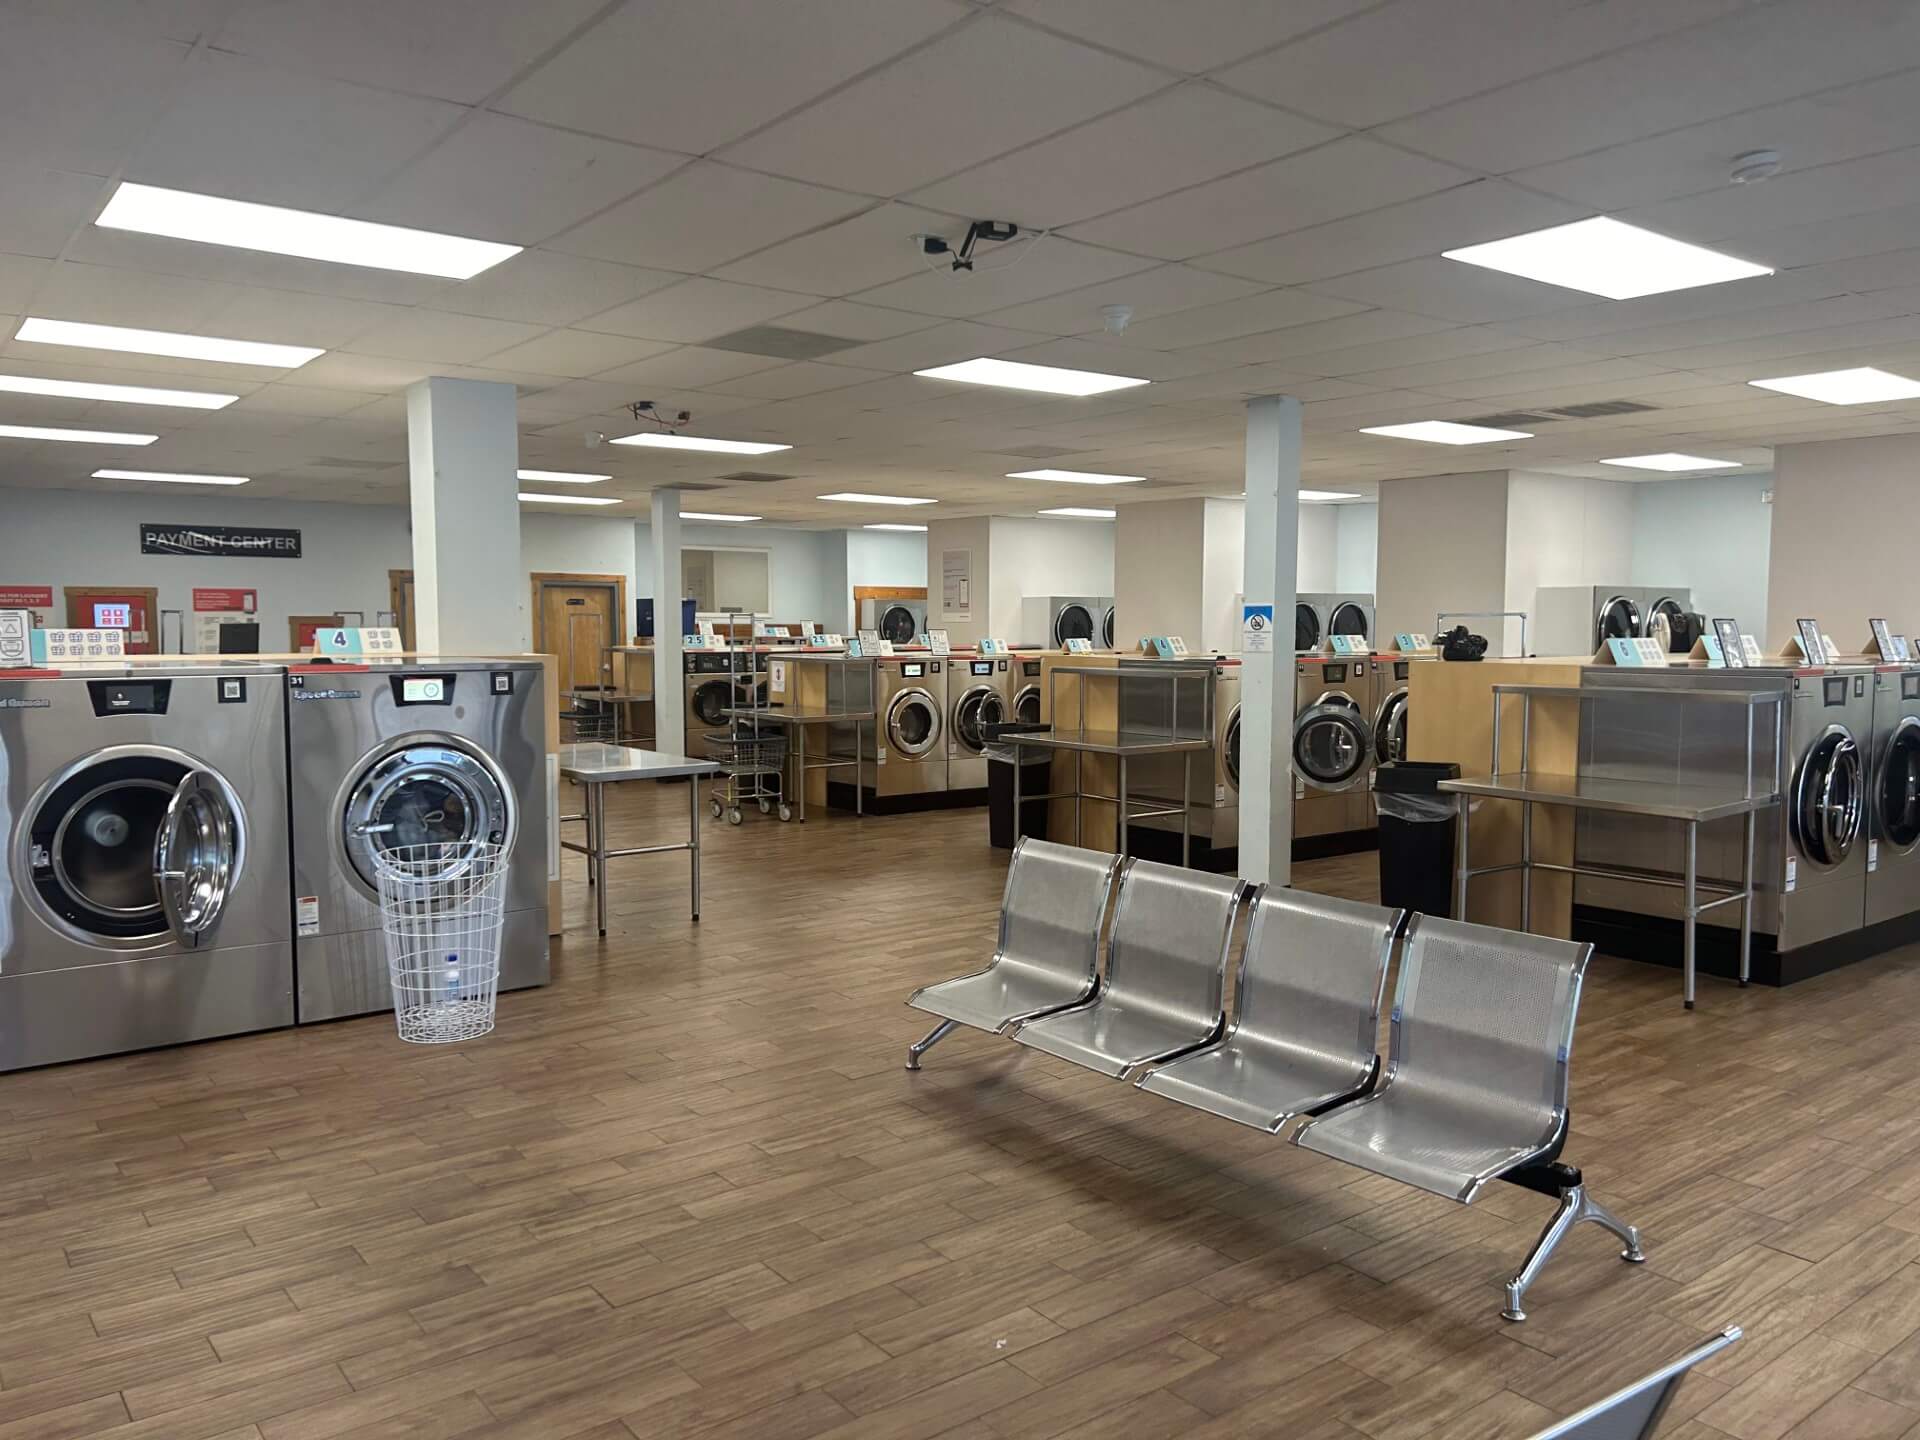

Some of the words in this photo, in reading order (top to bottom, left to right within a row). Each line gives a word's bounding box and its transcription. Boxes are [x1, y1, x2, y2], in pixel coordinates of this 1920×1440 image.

[146, 532, 226, 548] PAYMENT
[230, 536, 296, 550] CENTER
[334, 631, 347, 646] 4
[985, 640, 992, 649] 2
[291, 677, 303, 685] 31
